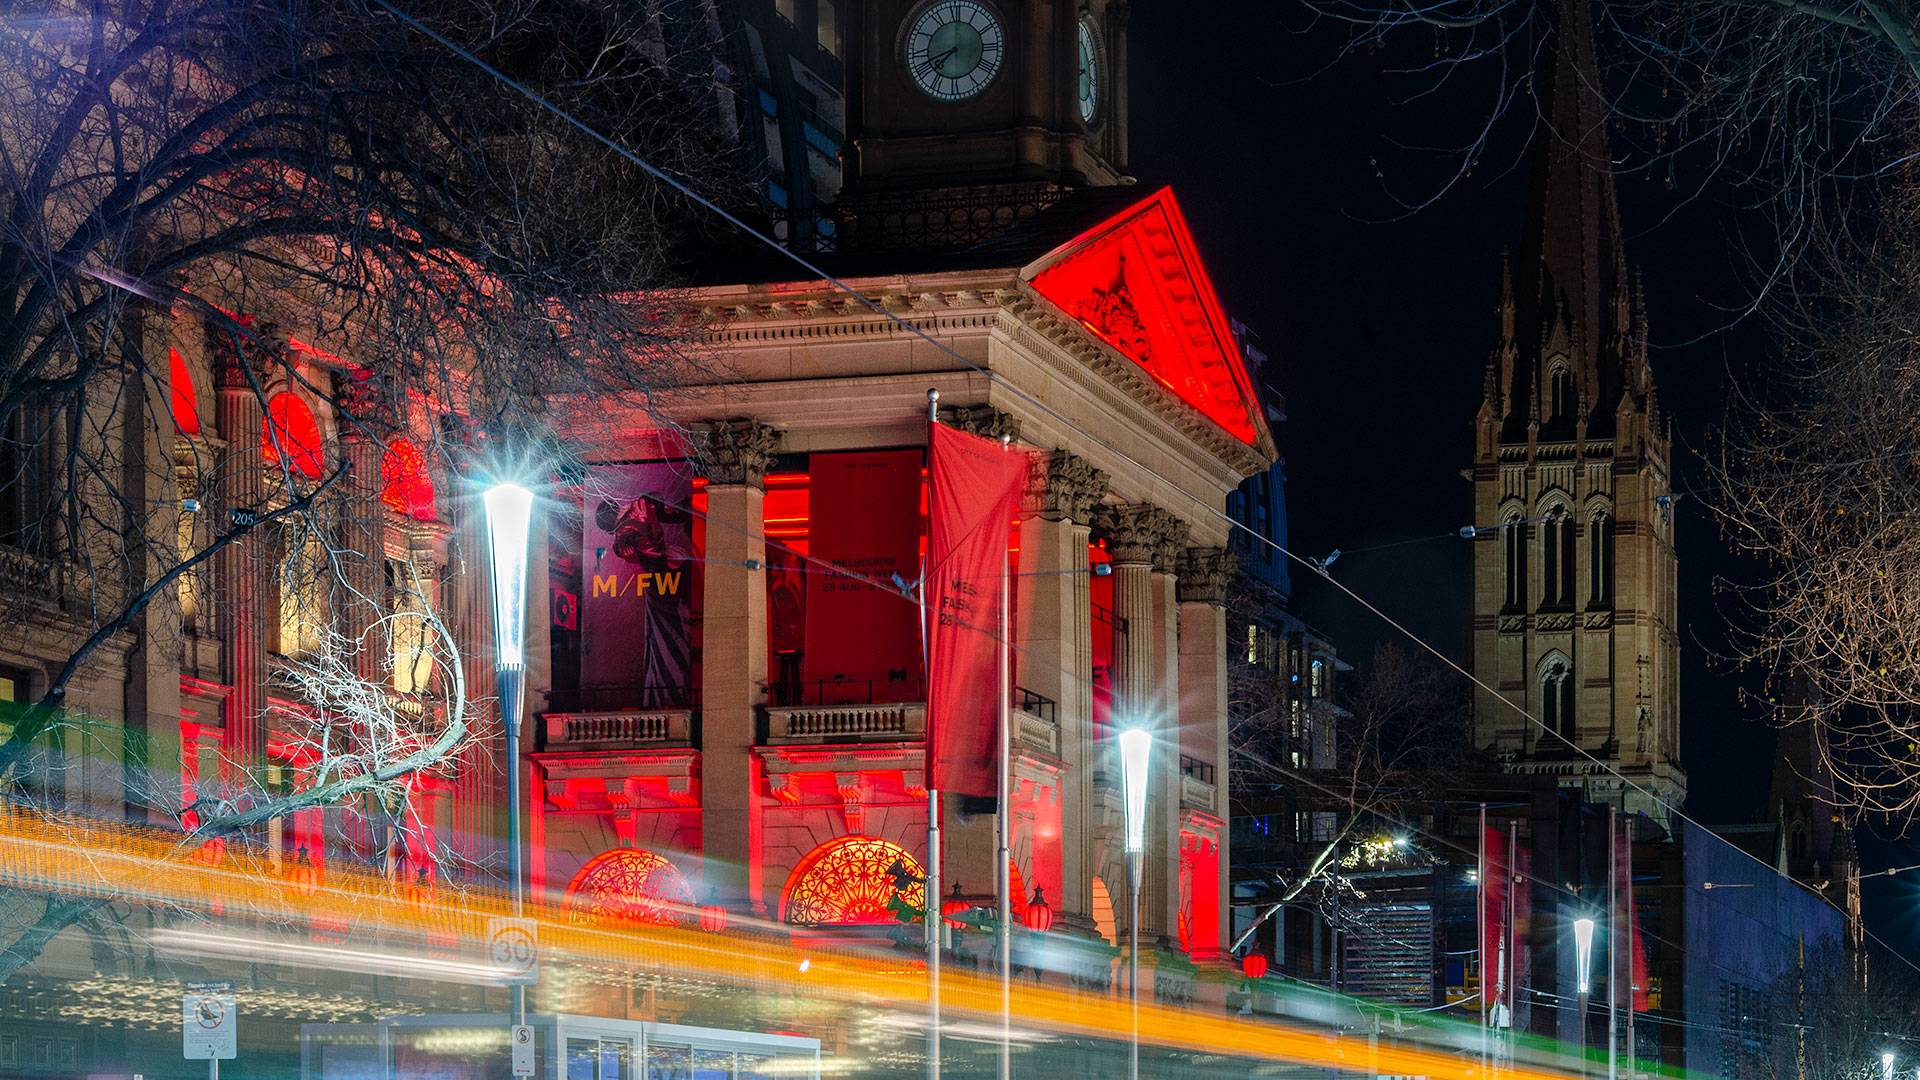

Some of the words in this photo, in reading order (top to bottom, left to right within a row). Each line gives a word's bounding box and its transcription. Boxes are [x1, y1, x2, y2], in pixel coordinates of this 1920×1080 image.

[235, 512, 254, 526] 205
[831, 557, 897, 568] MELBOURNE
[593, 572, 682, 598] M/FW
[496, 938, 530, 963] 30
